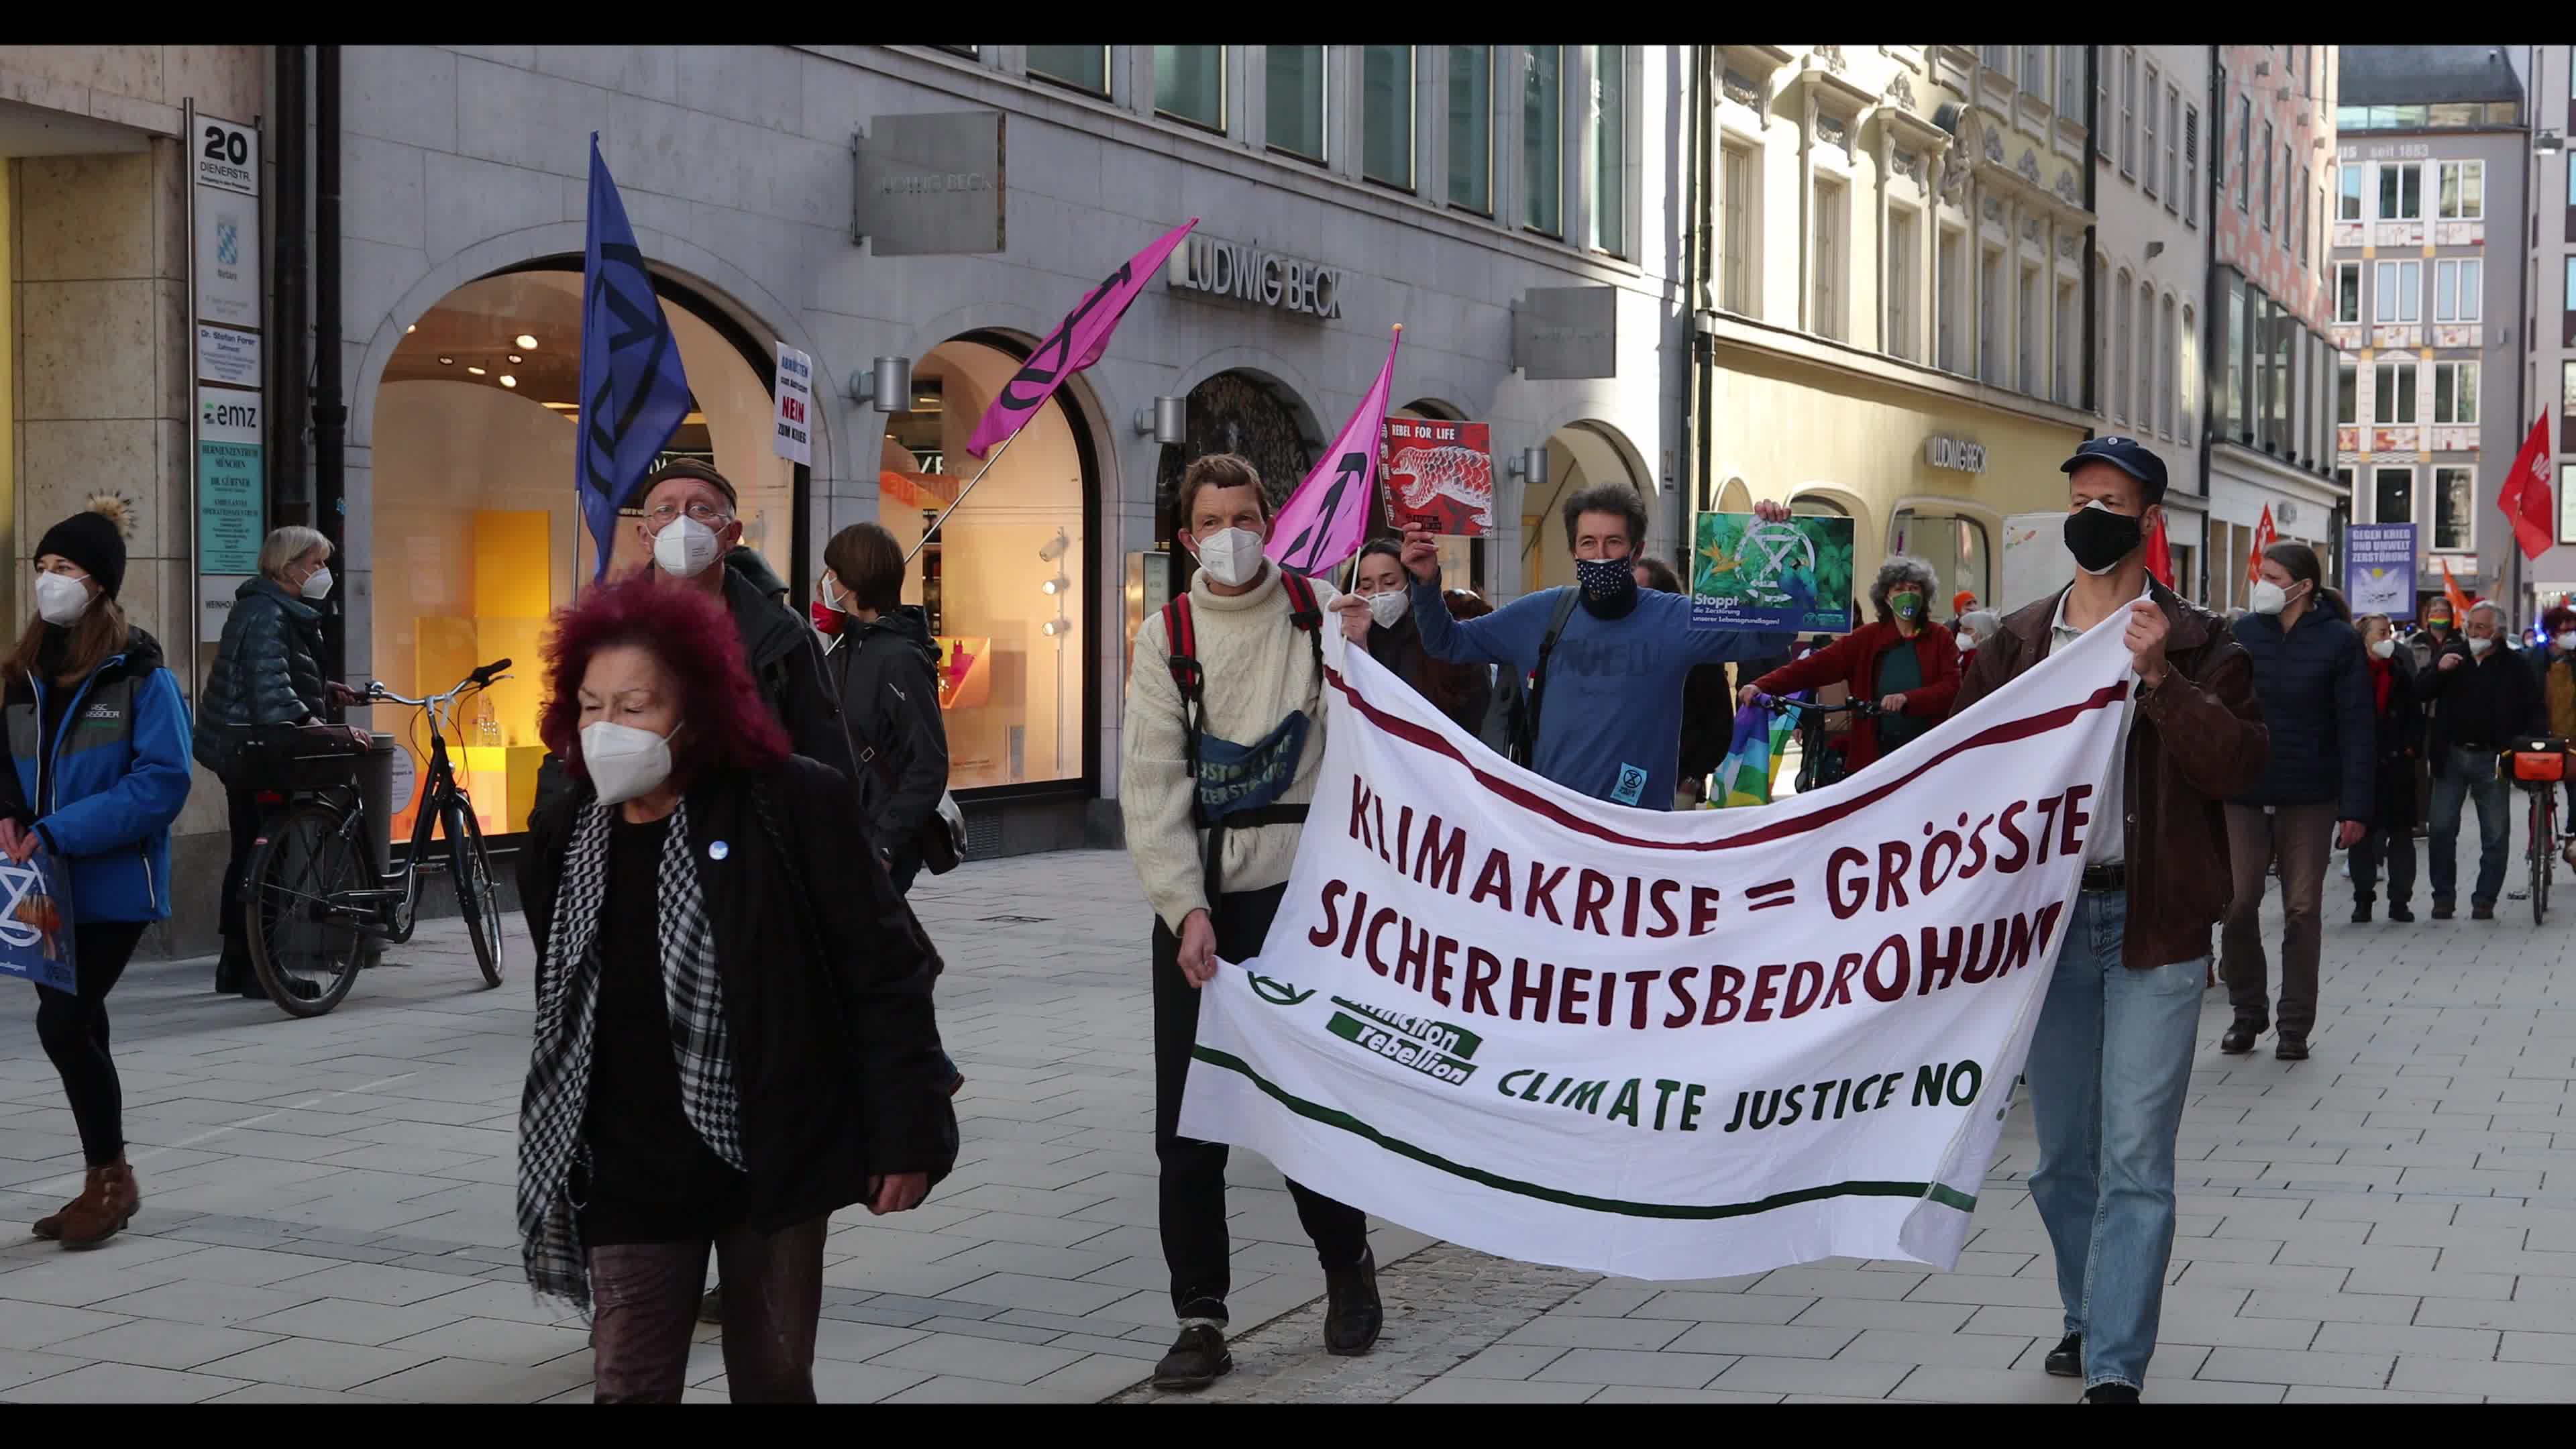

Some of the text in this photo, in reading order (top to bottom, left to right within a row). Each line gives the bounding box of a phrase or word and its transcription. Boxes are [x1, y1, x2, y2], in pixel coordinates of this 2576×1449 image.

[205, 125, 247, 166] 20
[200, 161, 252, 182] DIENERSTR.
[1185, 235, 1342, 318] LUDWIG BECK
[217, 404, 256, 429] emz
[782, 395, 804, 425] NEIN
[778, 423, 790, 438] ZUM
[1391, 423, 1455, 440] REBEL FOR LIFE
[1934, 436, 1986, 473] LUDWIG BECK
[2352, 529, 2410, 540] GEGEN KRIEG
[2353, 540, 2410, 551] UND UMWELT
[2352, 551, 2410, 563] ZERSTÖRUNG
[1695, 593, 1739, 609] Stoppt
[1705, 607, 1740, 616] Zerstörung
[1719, 616, 1780, 625] Lebensgrundlagen!
[1349, 773, 2093, 938] KLIMAKRISE = GRÖSSTE
[1355, 1025, 1468, 1084] rebellion
[1498, 1069, 1706, 1132] CLIMATE
[1724, 1072, 1904, 1132] JUSTICE
